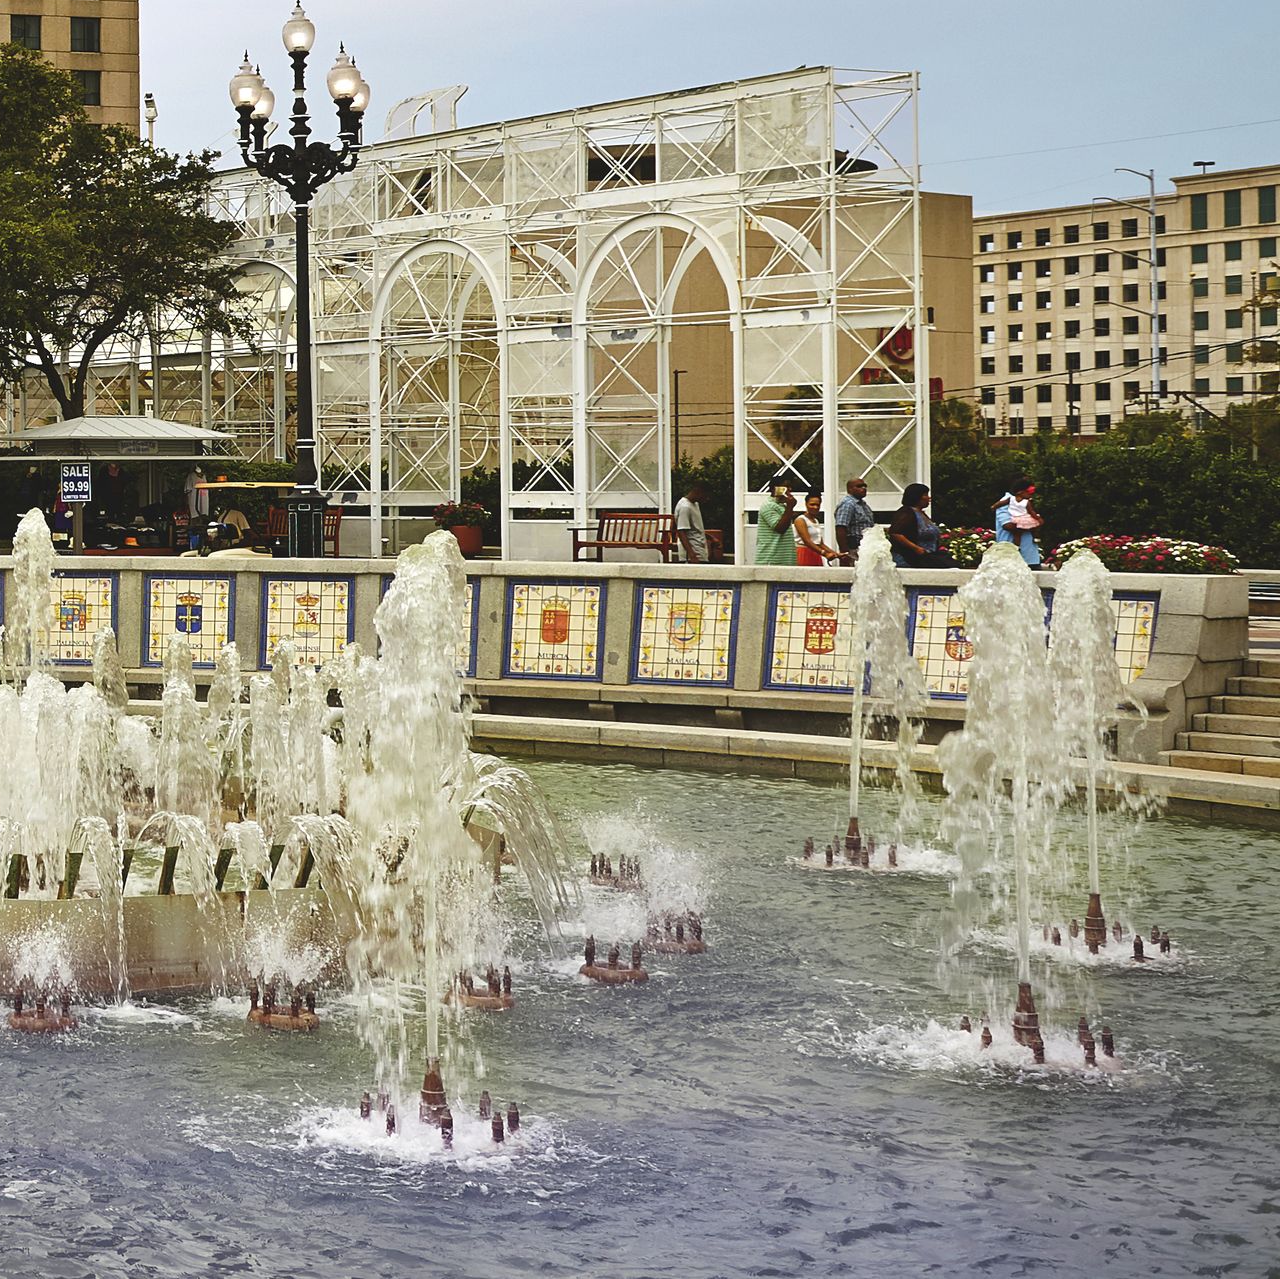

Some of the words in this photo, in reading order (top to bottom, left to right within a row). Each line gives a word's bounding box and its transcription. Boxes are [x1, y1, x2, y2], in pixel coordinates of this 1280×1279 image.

[62, 466, 89, 477] SALE
[63, 481, 89, 492] $9.99
[56, 639, 90, 647] PALENCIA
[538, 652, 569, 660] MURCIA
[801, 662, 837, 671] MADRID
